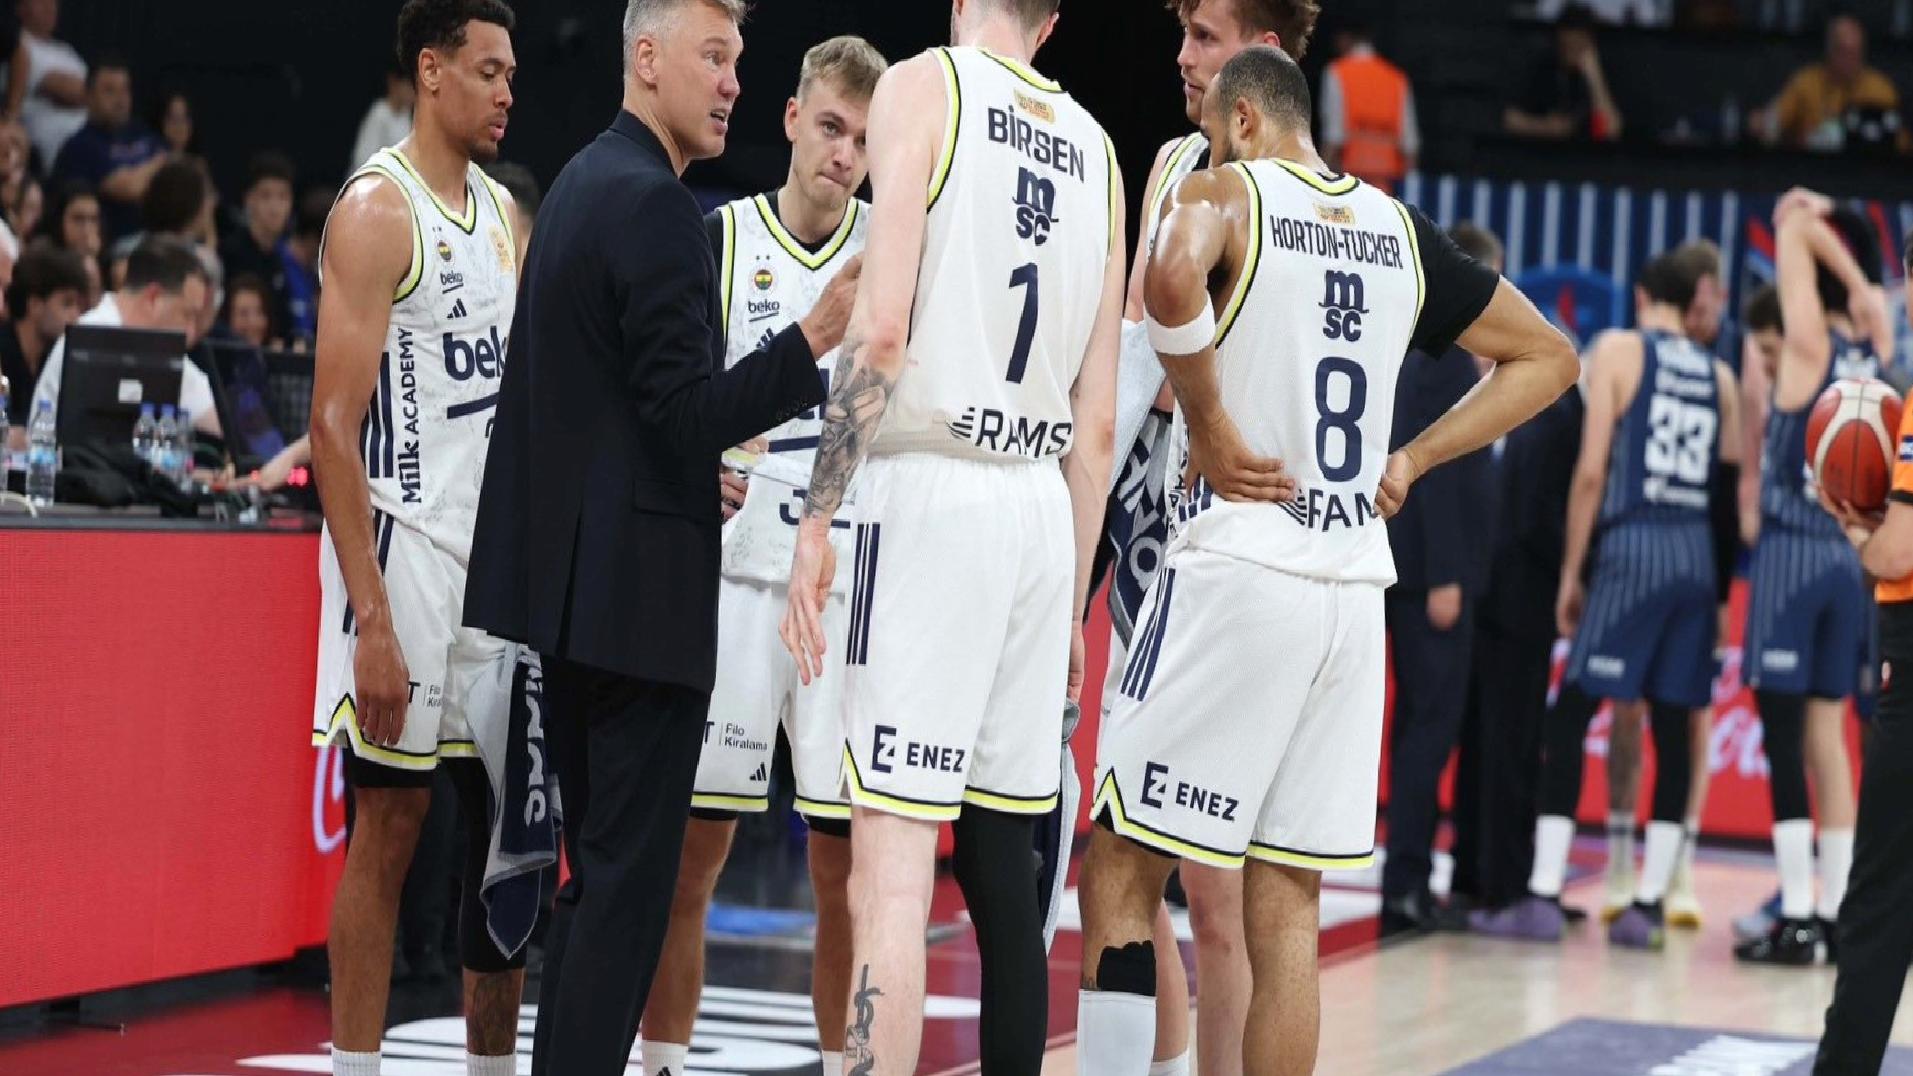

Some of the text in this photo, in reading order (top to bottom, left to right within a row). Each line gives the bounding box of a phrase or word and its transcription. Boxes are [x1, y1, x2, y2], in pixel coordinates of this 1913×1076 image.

[1269, 214, 1404, 269] HORTON-TUCKER
[440, 270, 463, 285] beko
[748, 299, 780, 314] beko
[1005, 262, 1038, 384] 1
[442, 325, 507, 382] bek
[398, 327, 421, 504] Milk ACADEMY
[974, 408, 1072, 458] RAMS
[1315, 356, 1367, 482] 8
[724, 736, 768, 751] Kiralama
[726, 722, 745, 737] Filo
[906, 742, 966, 774] ENEZ
[1175, 780, 1240, 822] ENEZ
